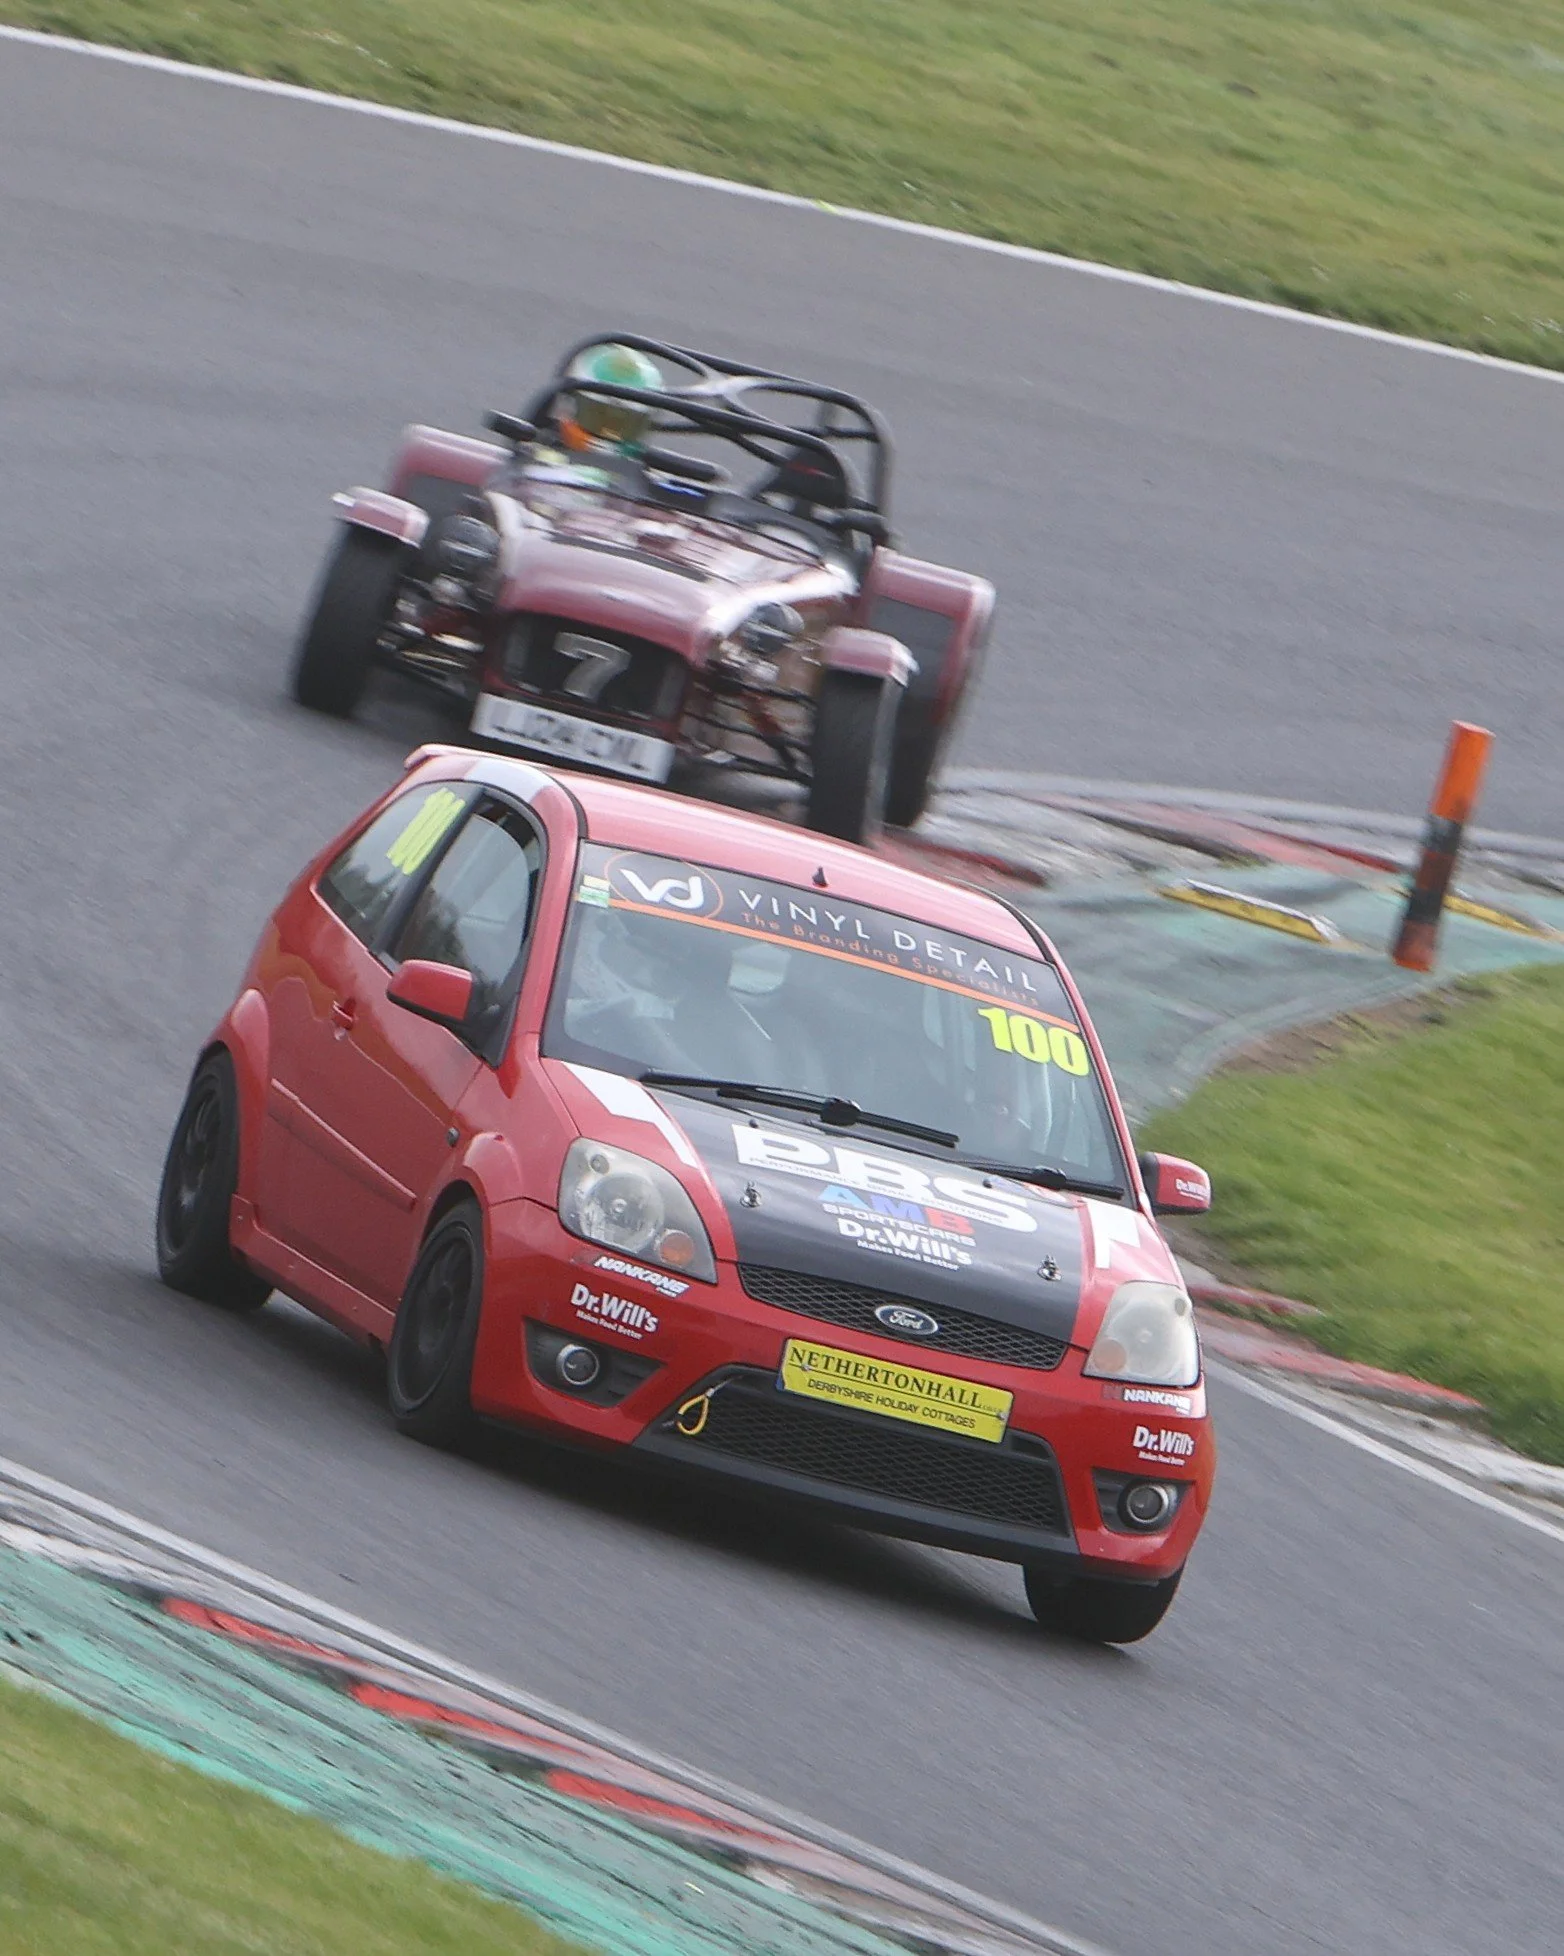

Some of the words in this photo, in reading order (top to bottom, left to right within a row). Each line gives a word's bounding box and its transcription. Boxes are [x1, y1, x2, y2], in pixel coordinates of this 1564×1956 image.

[555, 632, 632, 699] 7
[739, 889, 870, 939] VINYL
[893, 930, 1037, 991] DETAIL
[742, 912, 780, 930] The
[793, 925, 900, 965] Branding
[912, 957, 1039, 1007] Specialists
[978, 1007, 1089, 1076] 100
[731, 1124, 1038, 1232] PBS
[818, 1184, 975, 1235] AMB
[822, 1203, 976, 1247] SPORTSCARS
[837, 1217, 972, 1265] Dr.Will's
[571, 1283, 659, 1332] Dr.Will's
[889, 1311, 924, 1330] Ford
[789, 1346, 982, 1408] NETHERTONHALL
[808, 1378, 873, 1403] DERBYSHIRE
[876, 1394, 919, 1414] HOLIDAY
[922, 1407, 976, 1429] COTTAGES
[1133, 1425, 1195, 1456] Dr.Will's
